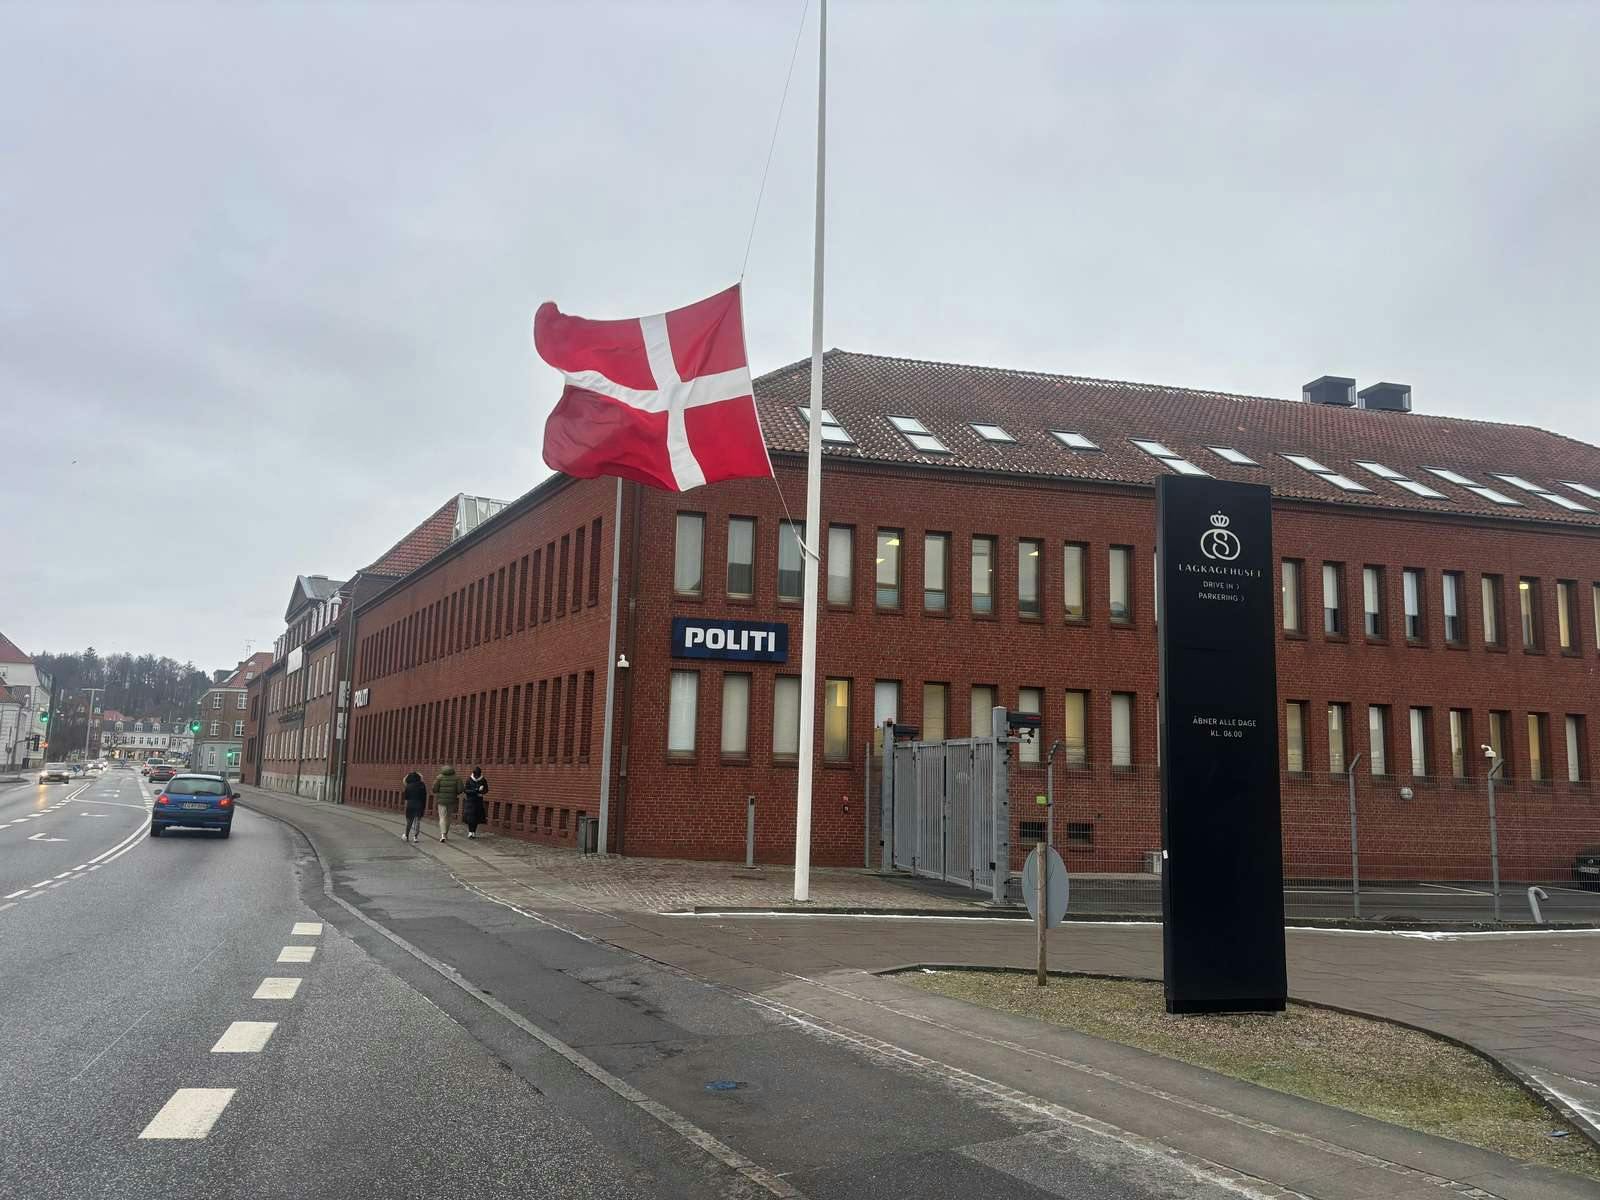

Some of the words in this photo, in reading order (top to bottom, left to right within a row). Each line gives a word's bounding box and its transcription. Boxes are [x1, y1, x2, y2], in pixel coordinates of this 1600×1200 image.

[1202, 580, 1225, 589] DRIVE
[1226, 582, 1234, 590] IN
[1198, 591, 1239, 602] PARKERING
[685, 626, 776, 652] POLITI
[1192, 715, 1218, 726] ÅBNER
[1219, 718, 1238, 727] ALLE
[1237, 719, 1257, 728] DAGE
[1223, 730, 1243, 738] 06.00
